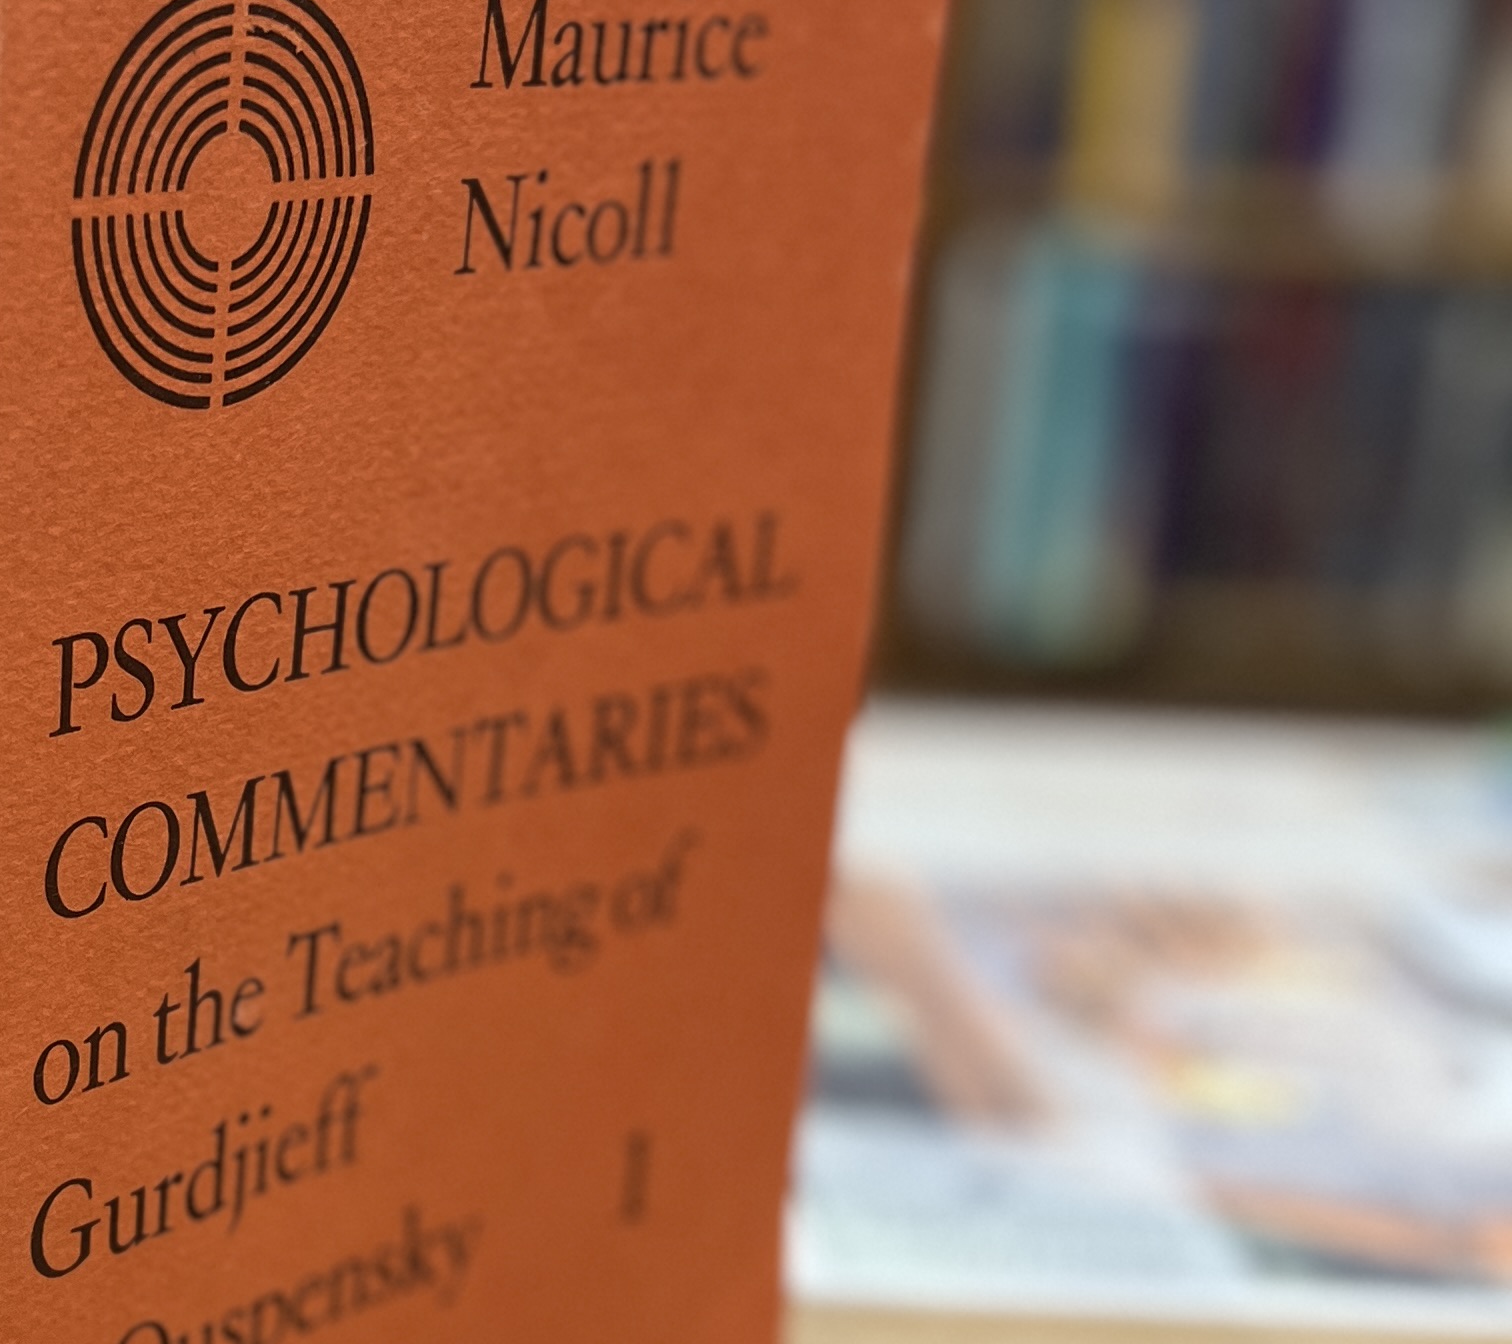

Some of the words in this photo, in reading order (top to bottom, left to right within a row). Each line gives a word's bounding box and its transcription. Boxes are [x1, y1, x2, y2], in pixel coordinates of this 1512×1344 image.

[453, 157, 683, 275] Nicoll
[47, 508, 800, 738] PSYCHOLOGICAL
[43, 665, 771, 918] COMMENTARIES
[31, 1019, 130, 1105] on
[153, 957, 266, 1065] the
[287, 869, 602, 1023] Teaching
[610, 824, 702, 936] of
[29, 1063, 382, 1279] Gurdjieff
